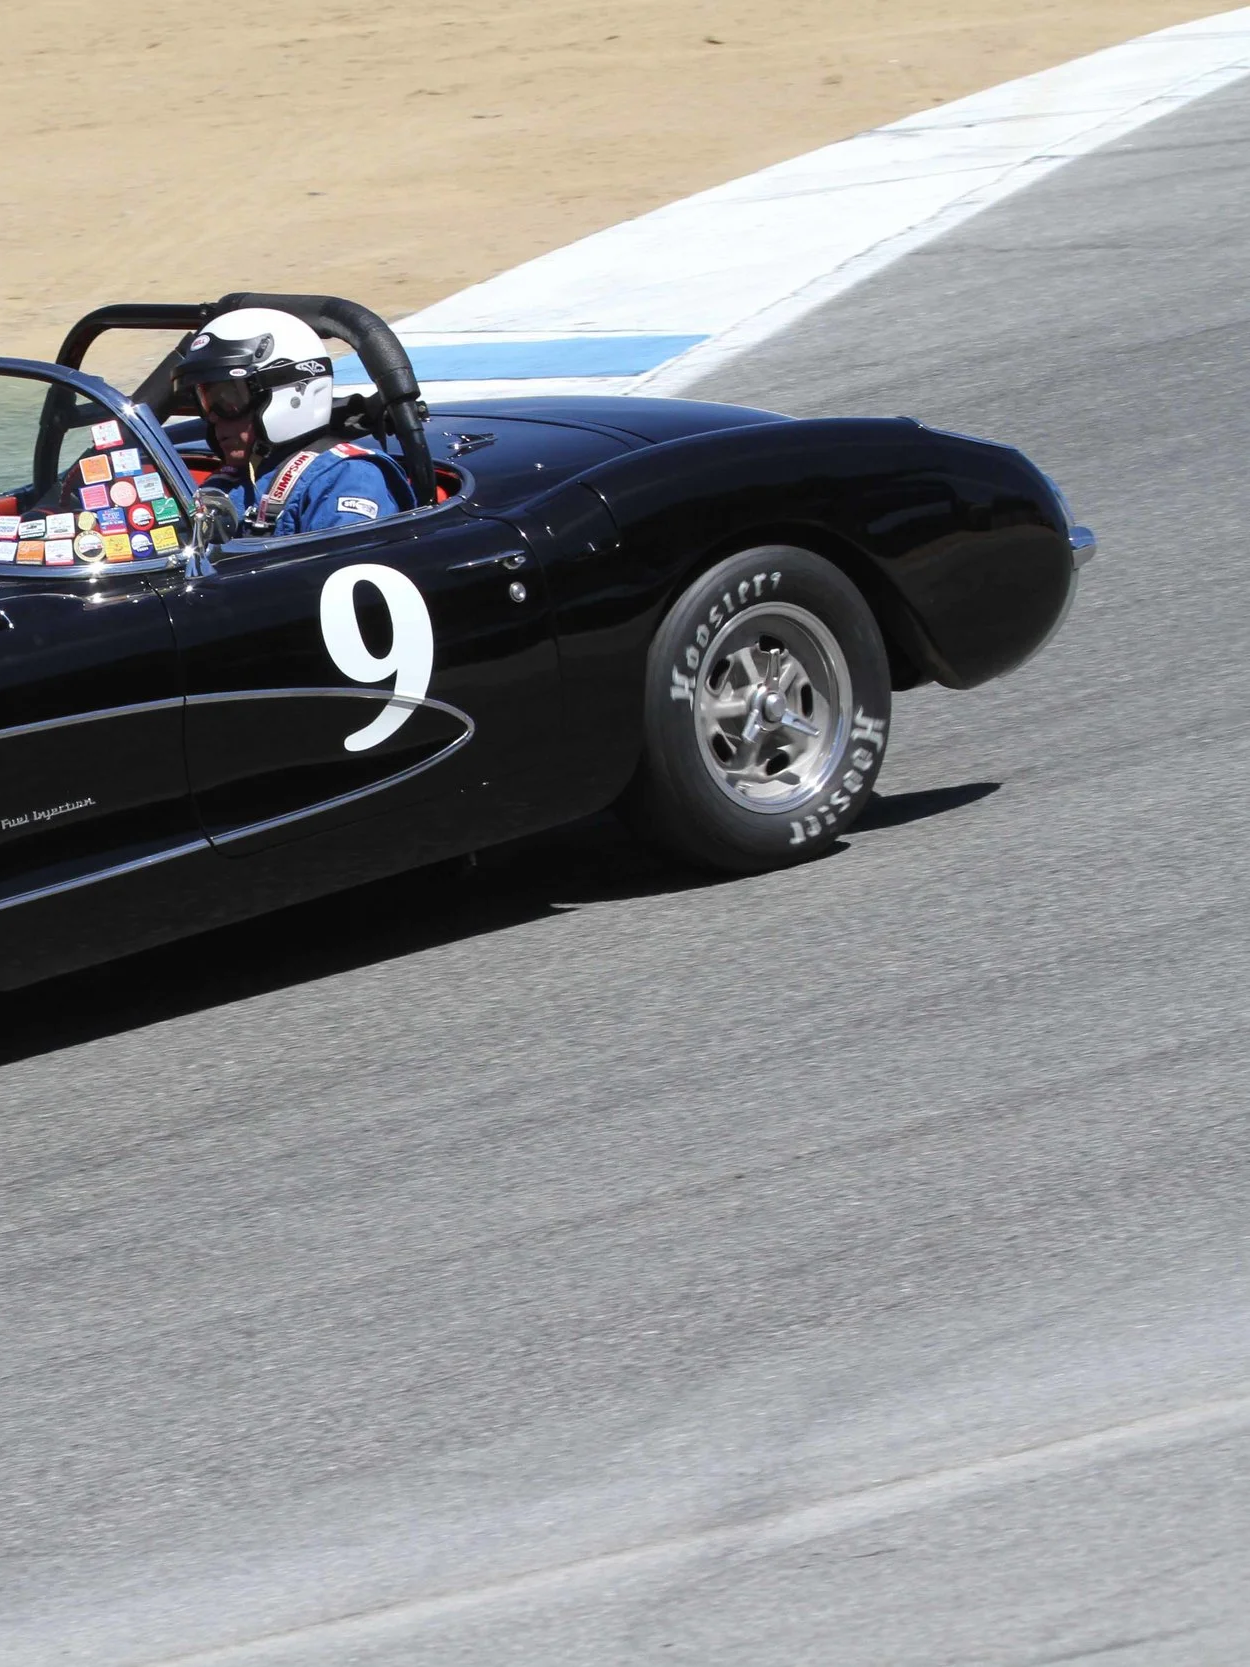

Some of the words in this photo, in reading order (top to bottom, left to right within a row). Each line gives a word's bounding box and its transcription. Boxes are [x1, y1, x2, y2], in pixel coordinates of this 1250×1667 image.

[272, 453, 311, 500] SIMPSON
[319, 563, 434, 752] 9
[0, 813, 29, 830] Fuel
[33, 797, 96, 821] Injection
